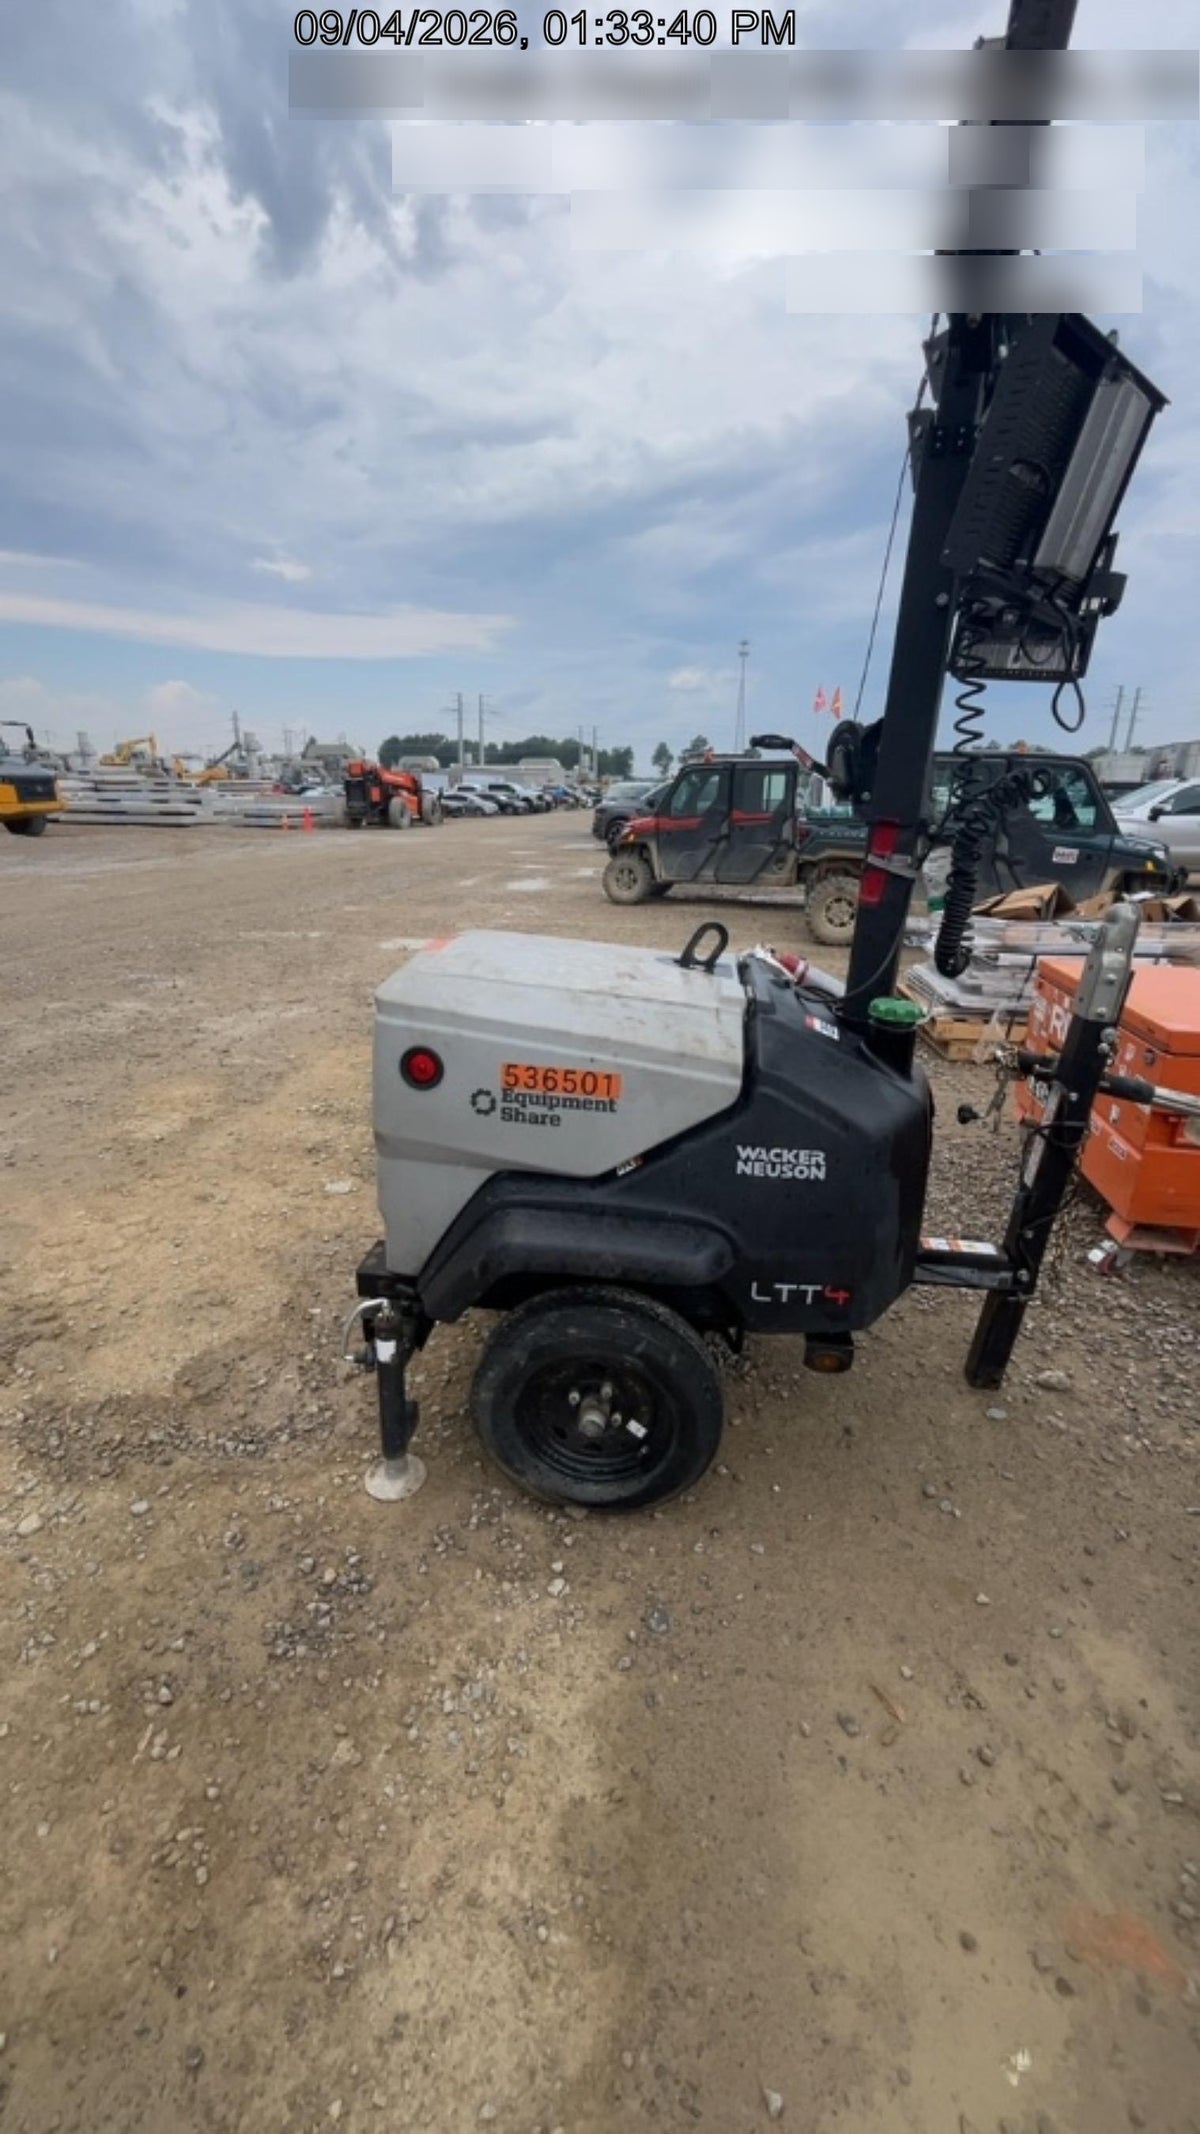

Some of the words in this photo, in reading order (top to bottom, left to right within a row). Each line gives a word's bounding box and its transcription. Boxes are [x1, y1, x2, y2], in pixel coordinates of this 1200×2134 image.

[504, 1064, 613, 1096] 536501
[501, 1088, 617, 1113] Equipment
[501, 1107, 561, 1127] Share
[736, 1145, 826, 1165] WACKER
[736, 1161, 826, 1180] NEUSON
[751, 1281, 849, 1305] LTT4
